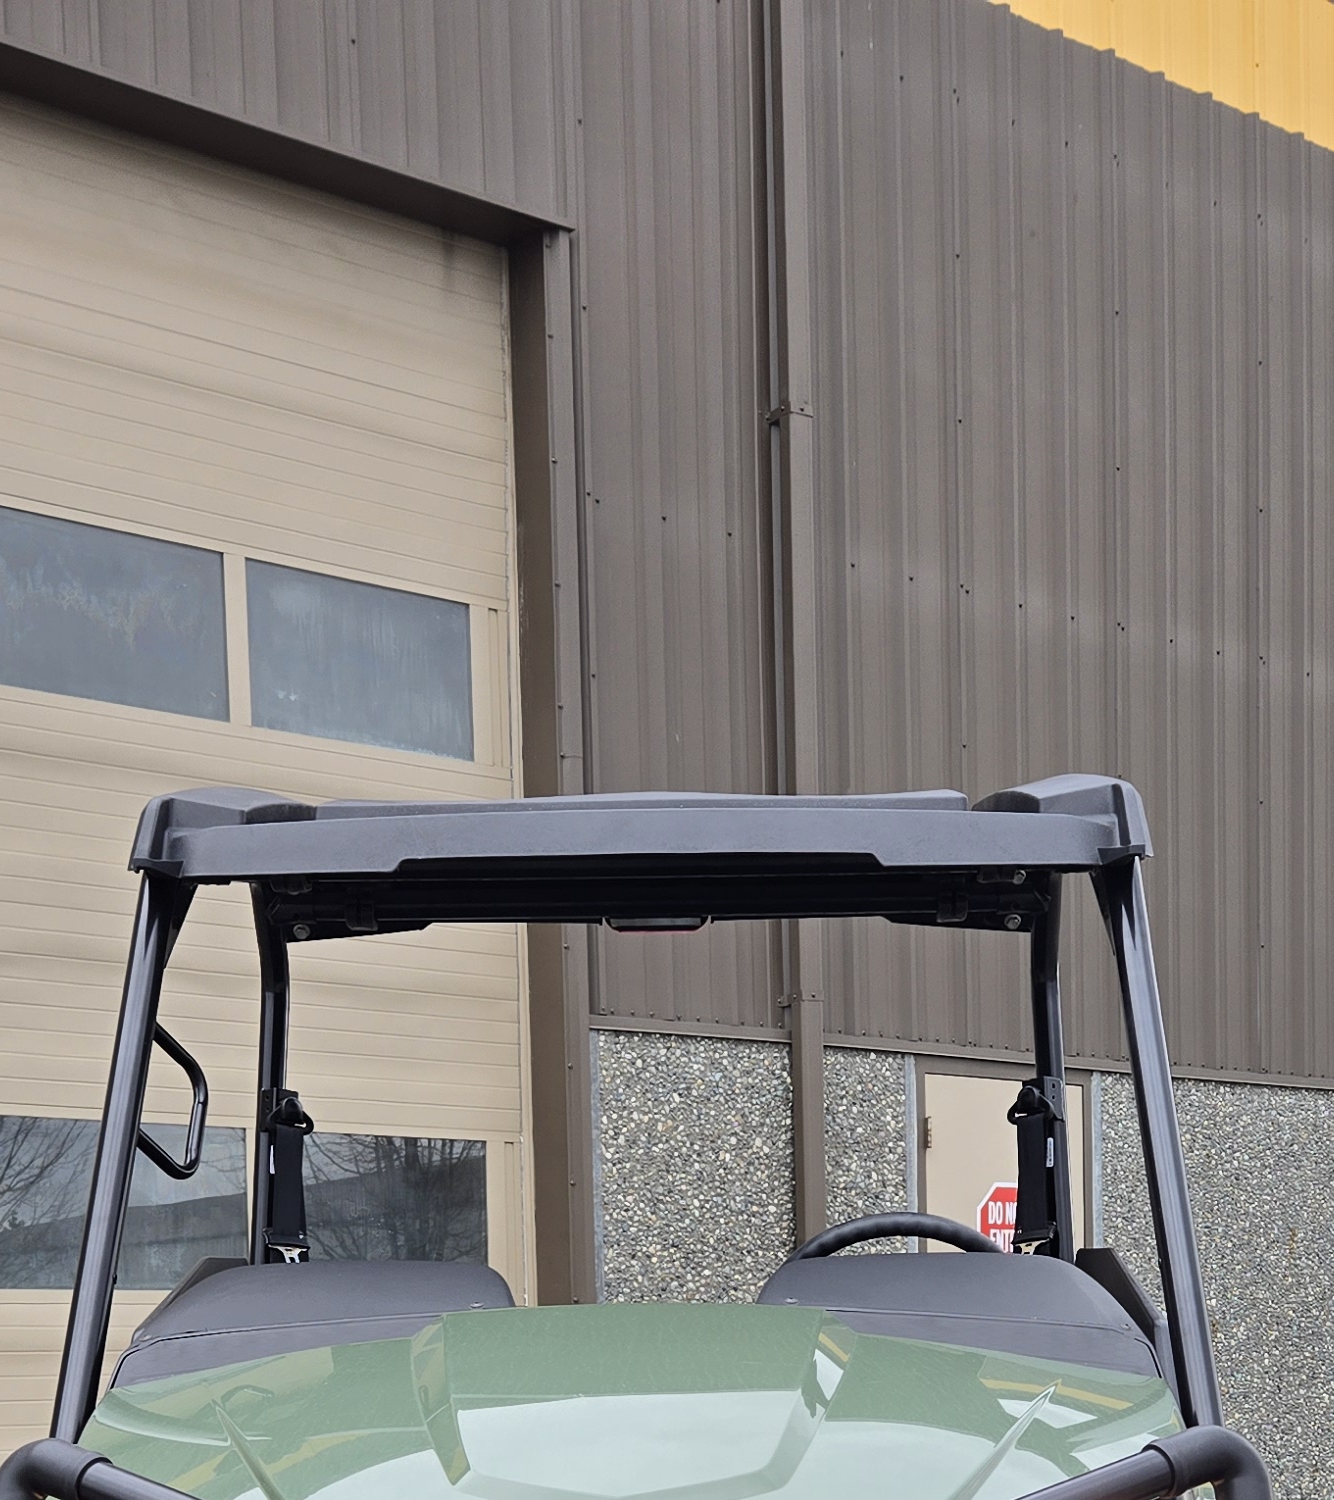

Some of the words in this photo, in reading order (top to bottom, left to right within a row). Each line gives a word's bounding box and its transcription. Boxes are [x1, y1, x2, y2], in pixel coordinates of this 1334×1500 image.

[988, 1201, 1003, 1225] DO
[1005, 1201, 1017, 1225] NO
[989, 1229, 1015, 1253] ENT
